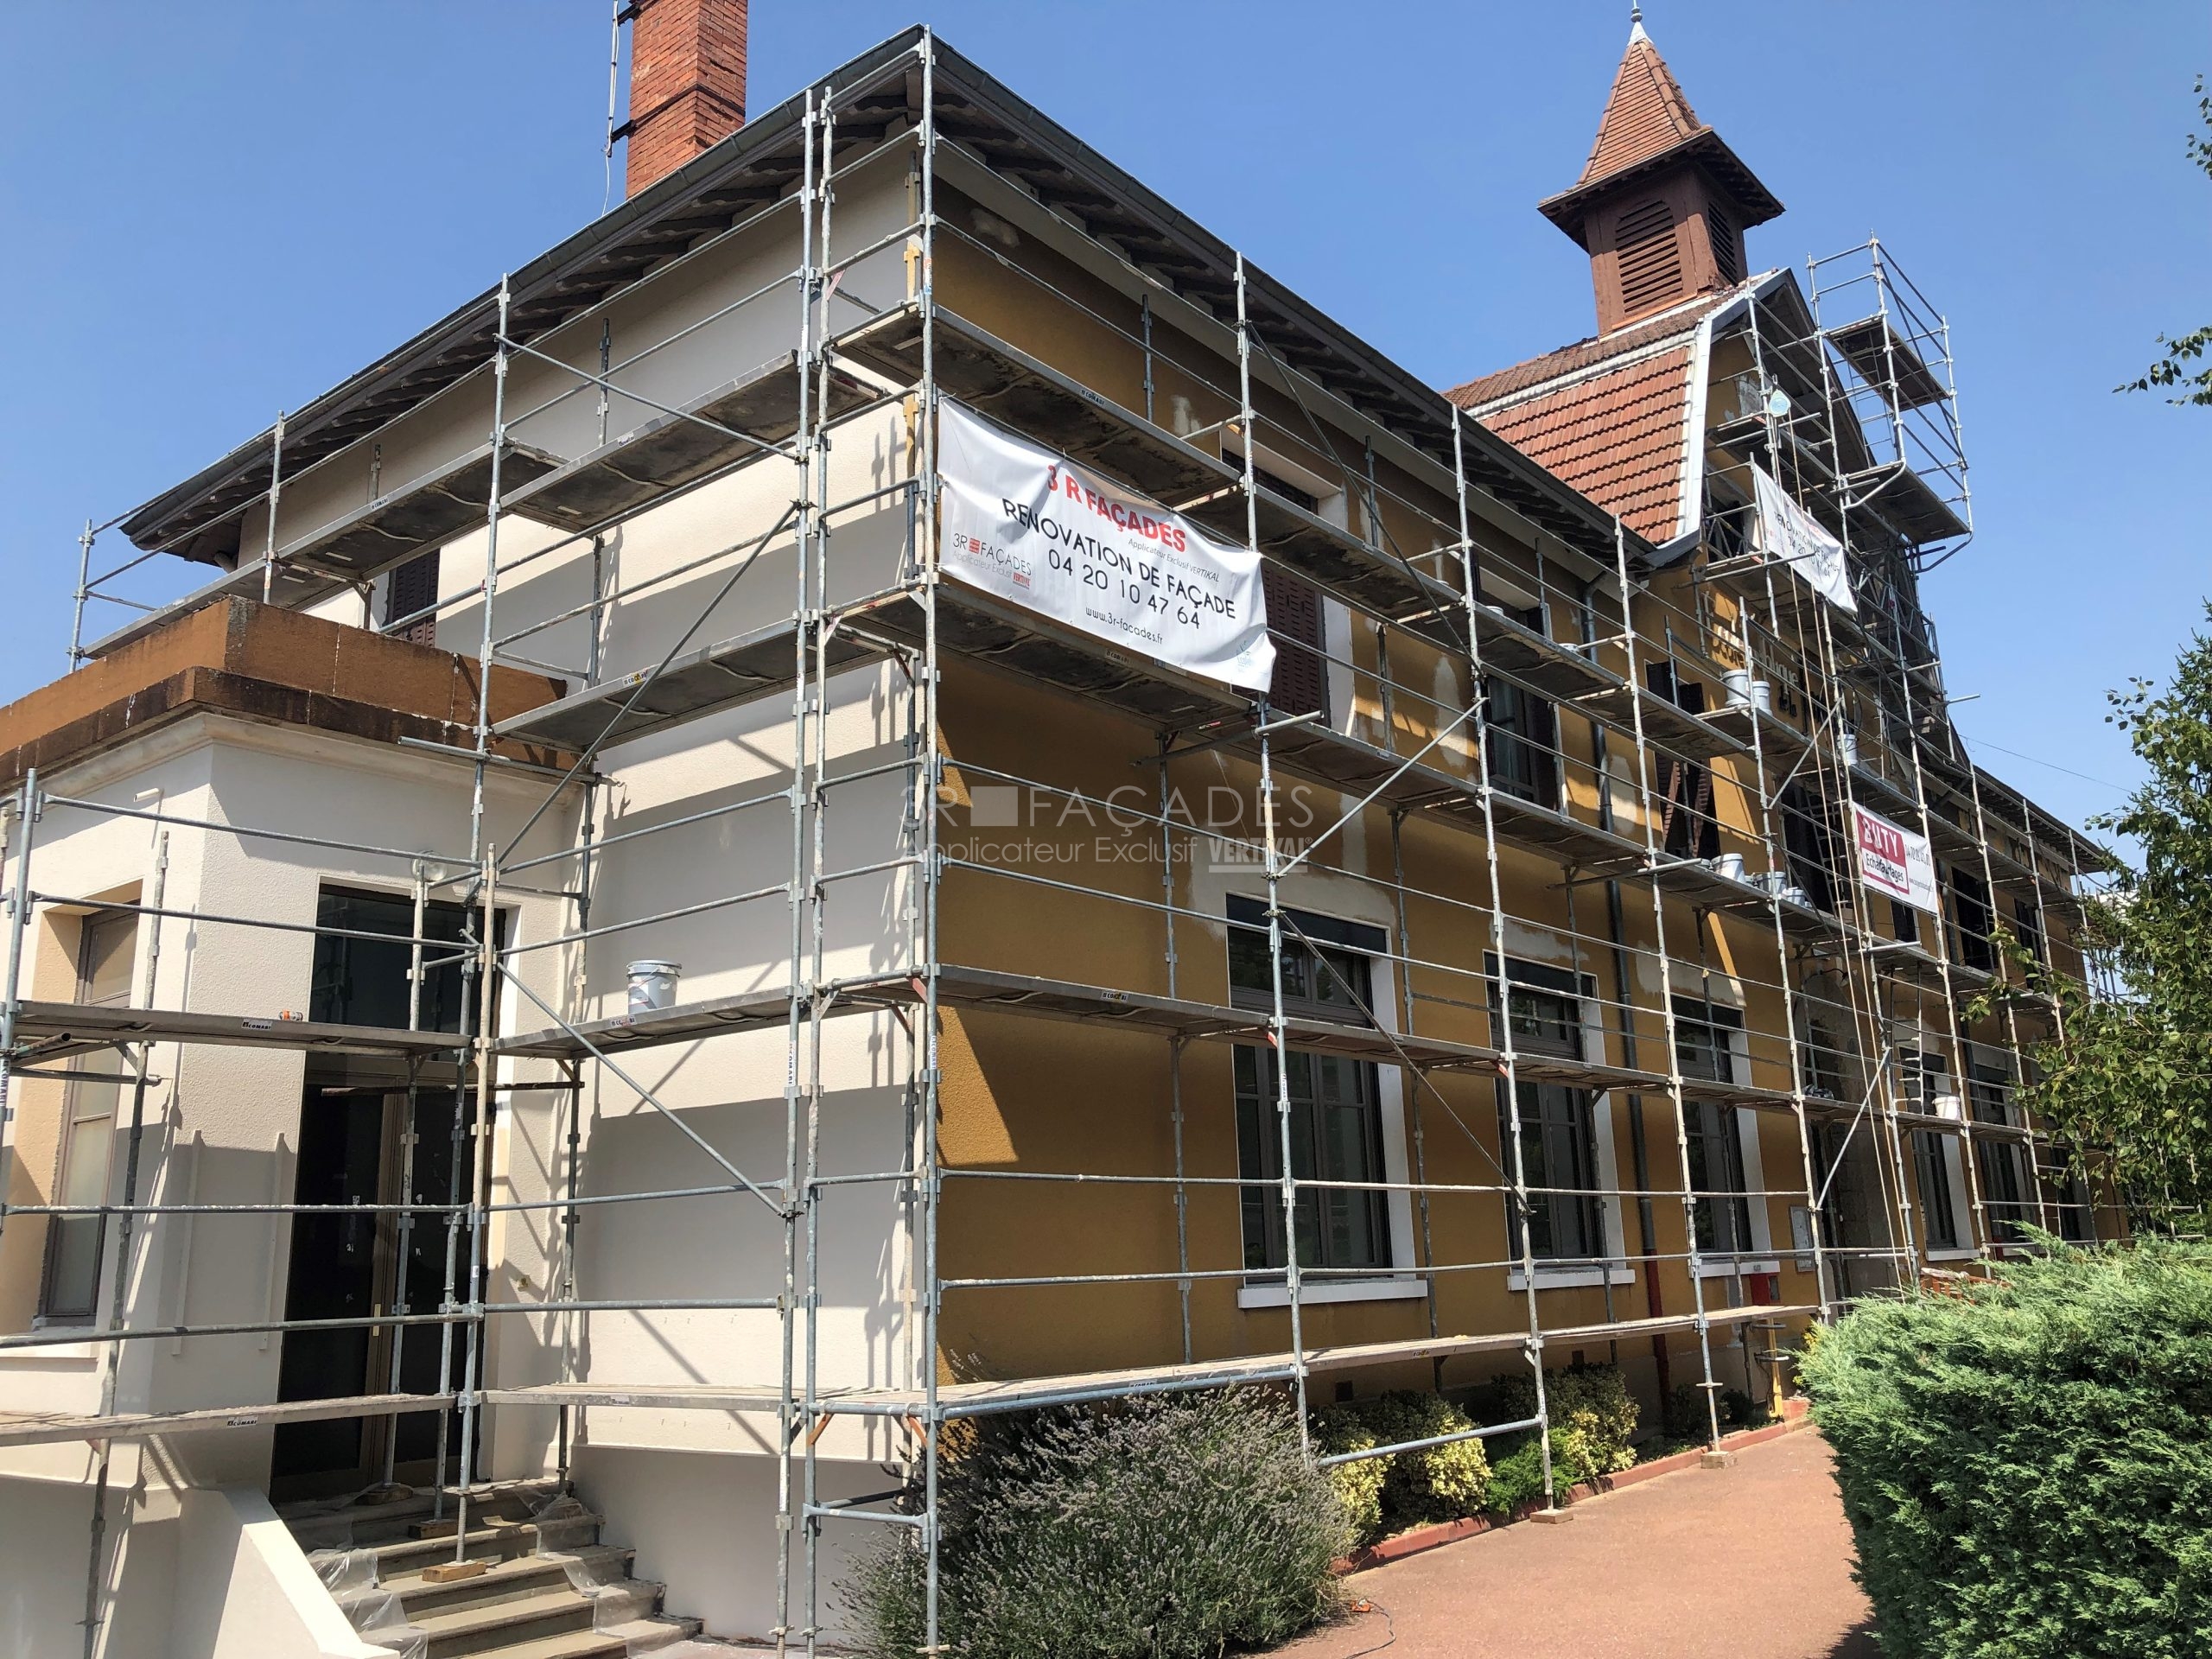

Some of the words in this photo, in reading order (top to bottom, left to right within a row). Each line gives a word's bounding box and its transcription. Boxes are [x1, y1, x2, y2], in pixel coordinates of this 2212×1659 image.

[1047, 464, 1058, 493] 3
[1065, 474, 1082, 504] R
[1086, 486, 1186, 554] FAÇADES
[953, 532, 968, 550] 3R
[980, 542, 1032, 576] FAÇADES
[1002, 497, 1133, 576] RENOVATION
[1139, 563, 1160, 589] DE
[1167, 574, 1236, 620] FAÇADE
[1128, 537, 1166, 563] Applicateur
[1166, 551, 1189, 571] Exclusif
[1189, 563, 1220, 583] VERTIKAL
[1048, 548, 1073, 576] 04
[1083, 563, 1109, 590] 20
[1121, 578, 1140, 604] 10
[1147, 594, 1170, 616] 47
[1177, 606, 1201, 630] 64
[1085, 605, 1164, 645] www.3r-facades.fr
[1862, 817, 1898, 857] BUTY
